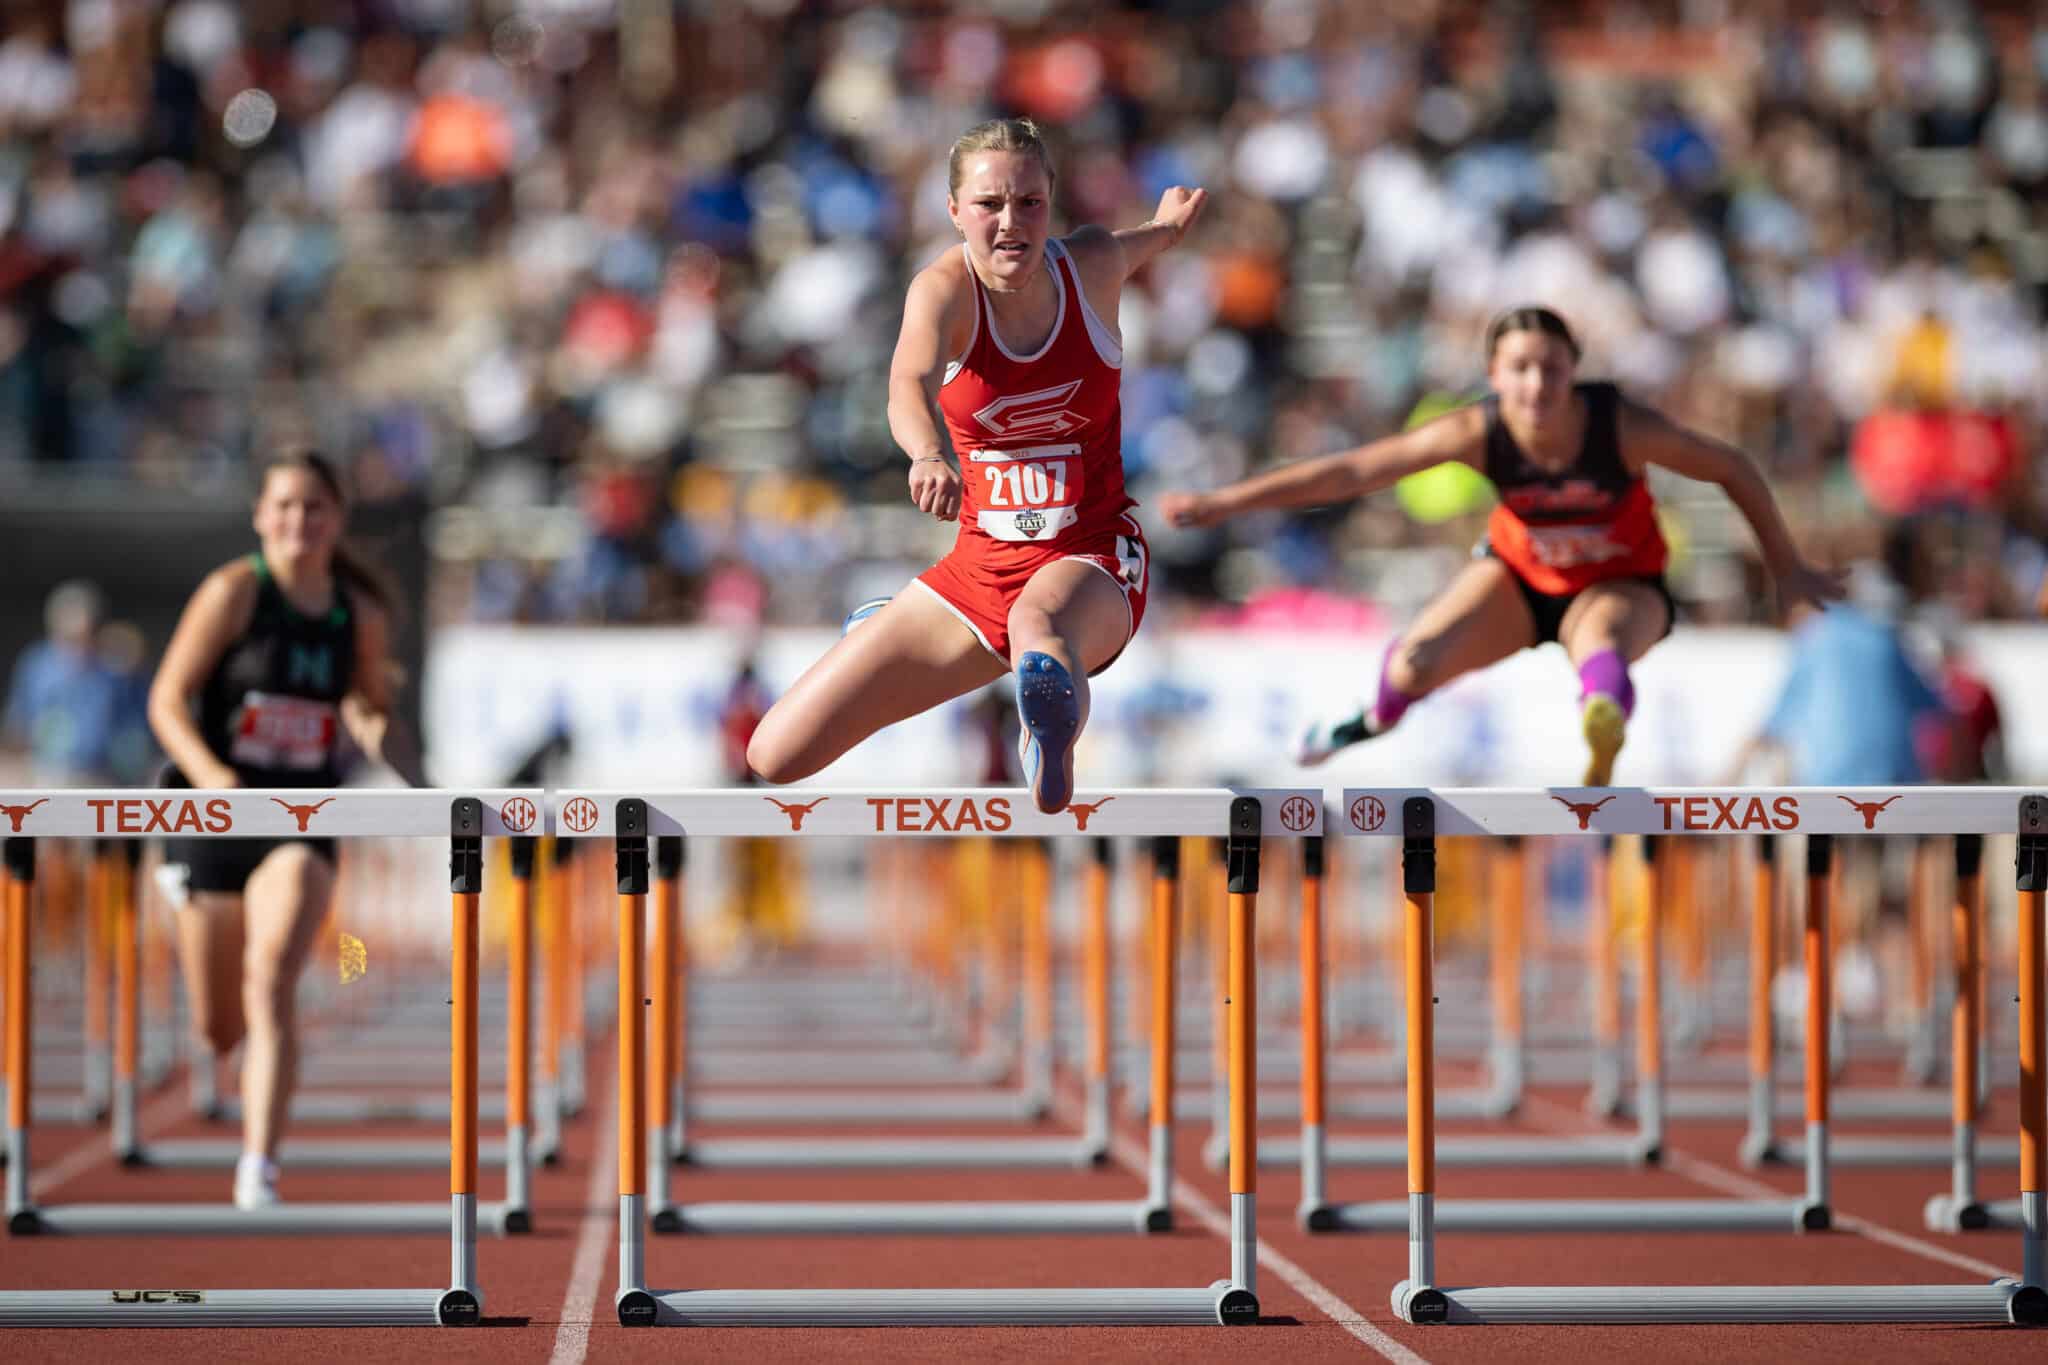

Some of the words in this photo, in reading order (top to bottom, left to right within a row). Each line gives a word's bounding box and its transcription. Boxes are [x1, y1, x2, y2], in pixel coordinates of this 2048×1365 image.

[985, 461, 1067, 506] 2107
[87, 799, 233, 833] TEXAS
[502, 797, 536, 832] SEC
[563, 797, 598, 832] SEC
[867, 797, 1013, 832] TEXAS
[1280, 796, 1315, 831] SEC
[1351, 796, 1386, 831] SEC
[1653, 796, 1800, 831] TEXAS
[112, 1290, 201, 1303] UCS
